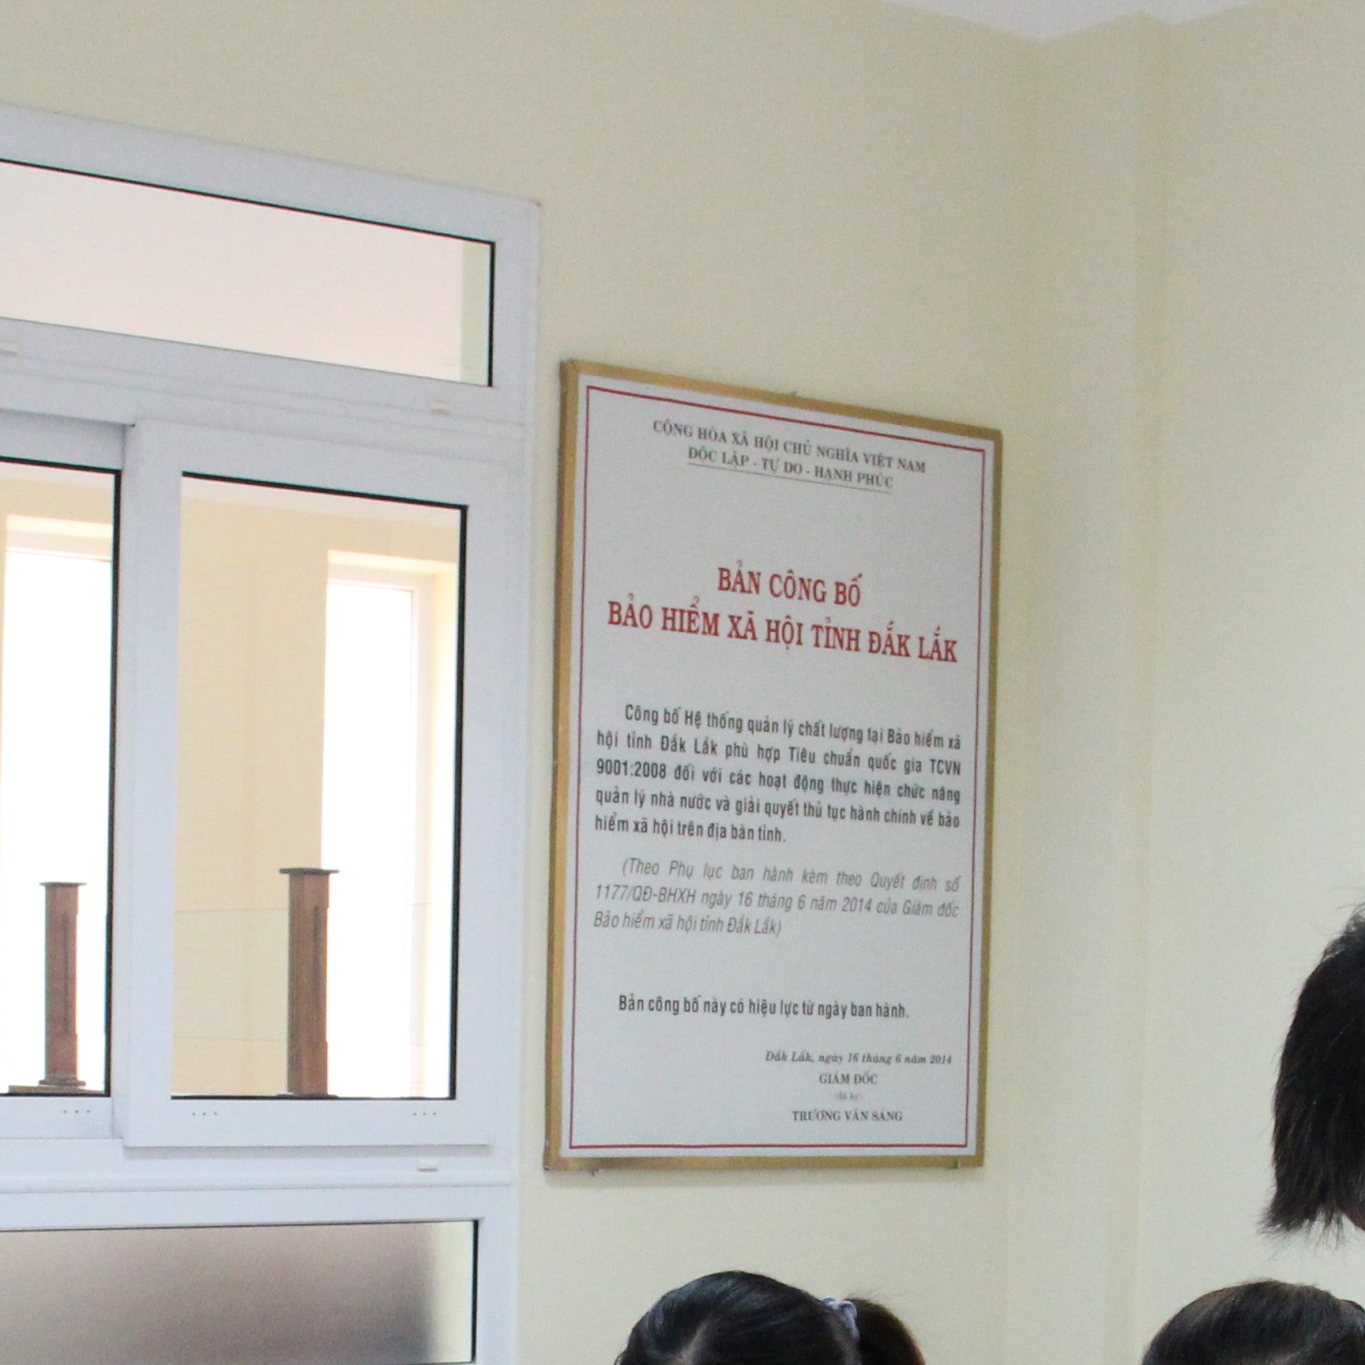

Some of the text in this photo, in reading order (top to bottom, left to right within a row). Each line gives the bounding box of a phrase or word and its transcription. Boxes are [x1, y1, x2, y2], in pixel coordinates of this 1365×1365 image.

[783, 461, 803, 475] DO
[897, 457, 926, 474] NAM
[718, 560, 863, 607] BẢN CÔNG BỐ
[607, 593, 958, 662] BẢO HIỂM XÃ HỘI TỈNH ĐẮK LẮK
[625, 704, 961, 750] Công bố Hệ thống quản lý chất lượng tại Bảo hiểm xã
[597, 730, 618, 748] hội
[627, 731, 652, 750] tỉnh
[660, 733, 686, 752] Đắk
[694, 736, 718, 755] Lắk
[725, 742, 748, 760] phù
[757, 743, 781, 764] hợp
[788, 746, 816, 764] Tiêu
[868, 752, 897, 772] quốc
[904, 754, 922, 775] gia
[929, 758, 961, 776] TCVN
[596, 758, 667, 779] 9001:2008
[674, 763, 695, 781] đối
[702, 766, 722, 783] với
[729, 768, 751, 786] các
[759, 771, 787, 790] hoạt
[793, 773, 824, 795] động
[831, 776, 858, 796] thực
[864, 780, 891, 799] hiện
[596, 786, 629, 805] quản
[634, 789, 646, 808] lý
[650, 791, 674, 807] nhà
[680, 793, 711, 810] nước
[716, 795, 730, 811] và
[735, 795, 760, 816] giải
[764, 798, 800, 818] quyết
[803, 801, 822, 818] thủ
[827, 804, 846, 821] tục
[850, 805, 880, 822] hành
[884, 809, 916, 825] chính
[938, 811, 960, 828] bảo
[595, 812, 629, 832] hiểm
[633, 817, 648, 833] xã
[653, 818, 673, 837] hội
[677, 820, 703, 837] trên
[707, 822, 727, 841] địa
[731, 824, 754, 841] bàn
[622, 857, 962, 893] (Theo Phụ lục ban hành kèm theo Quyết định số
[593, 910, 619, 928] Bảo
[622, 910, 655, 929] hiểm
[658, 914, 673, 930] xã
[676, 915, 697, 933] hội
[699, 916, 724, 933] tỉnh
[727, 915, 751, 934] Đắk
[701, 890, 733, 909] ngày
[737, 891, 753, 907] 16
[757, 892, 793, 912] tháng
[797, 894, 806, 910] 6
[809, 895, 836, 911] năm
[841, 896, 872, 912] 2014
[876, 898, 897, 914] của
[902, 899, 933, 916] Giám
[937, 900, 959, 918] đốc
[618, 993, 644, 1012] Bản
[648, 996, 680, 1015] công
[684, 994, 701, 1013] bố
[703, 997, 727, 1017] này
[729, 998, 744, 1014] có
[748, 998, 776, 1018] hiệu
[780, 999, 799, 1018] lực
[818, 1003, 847, 1020] ngày
[850, 1003, 873, 1018] ban
